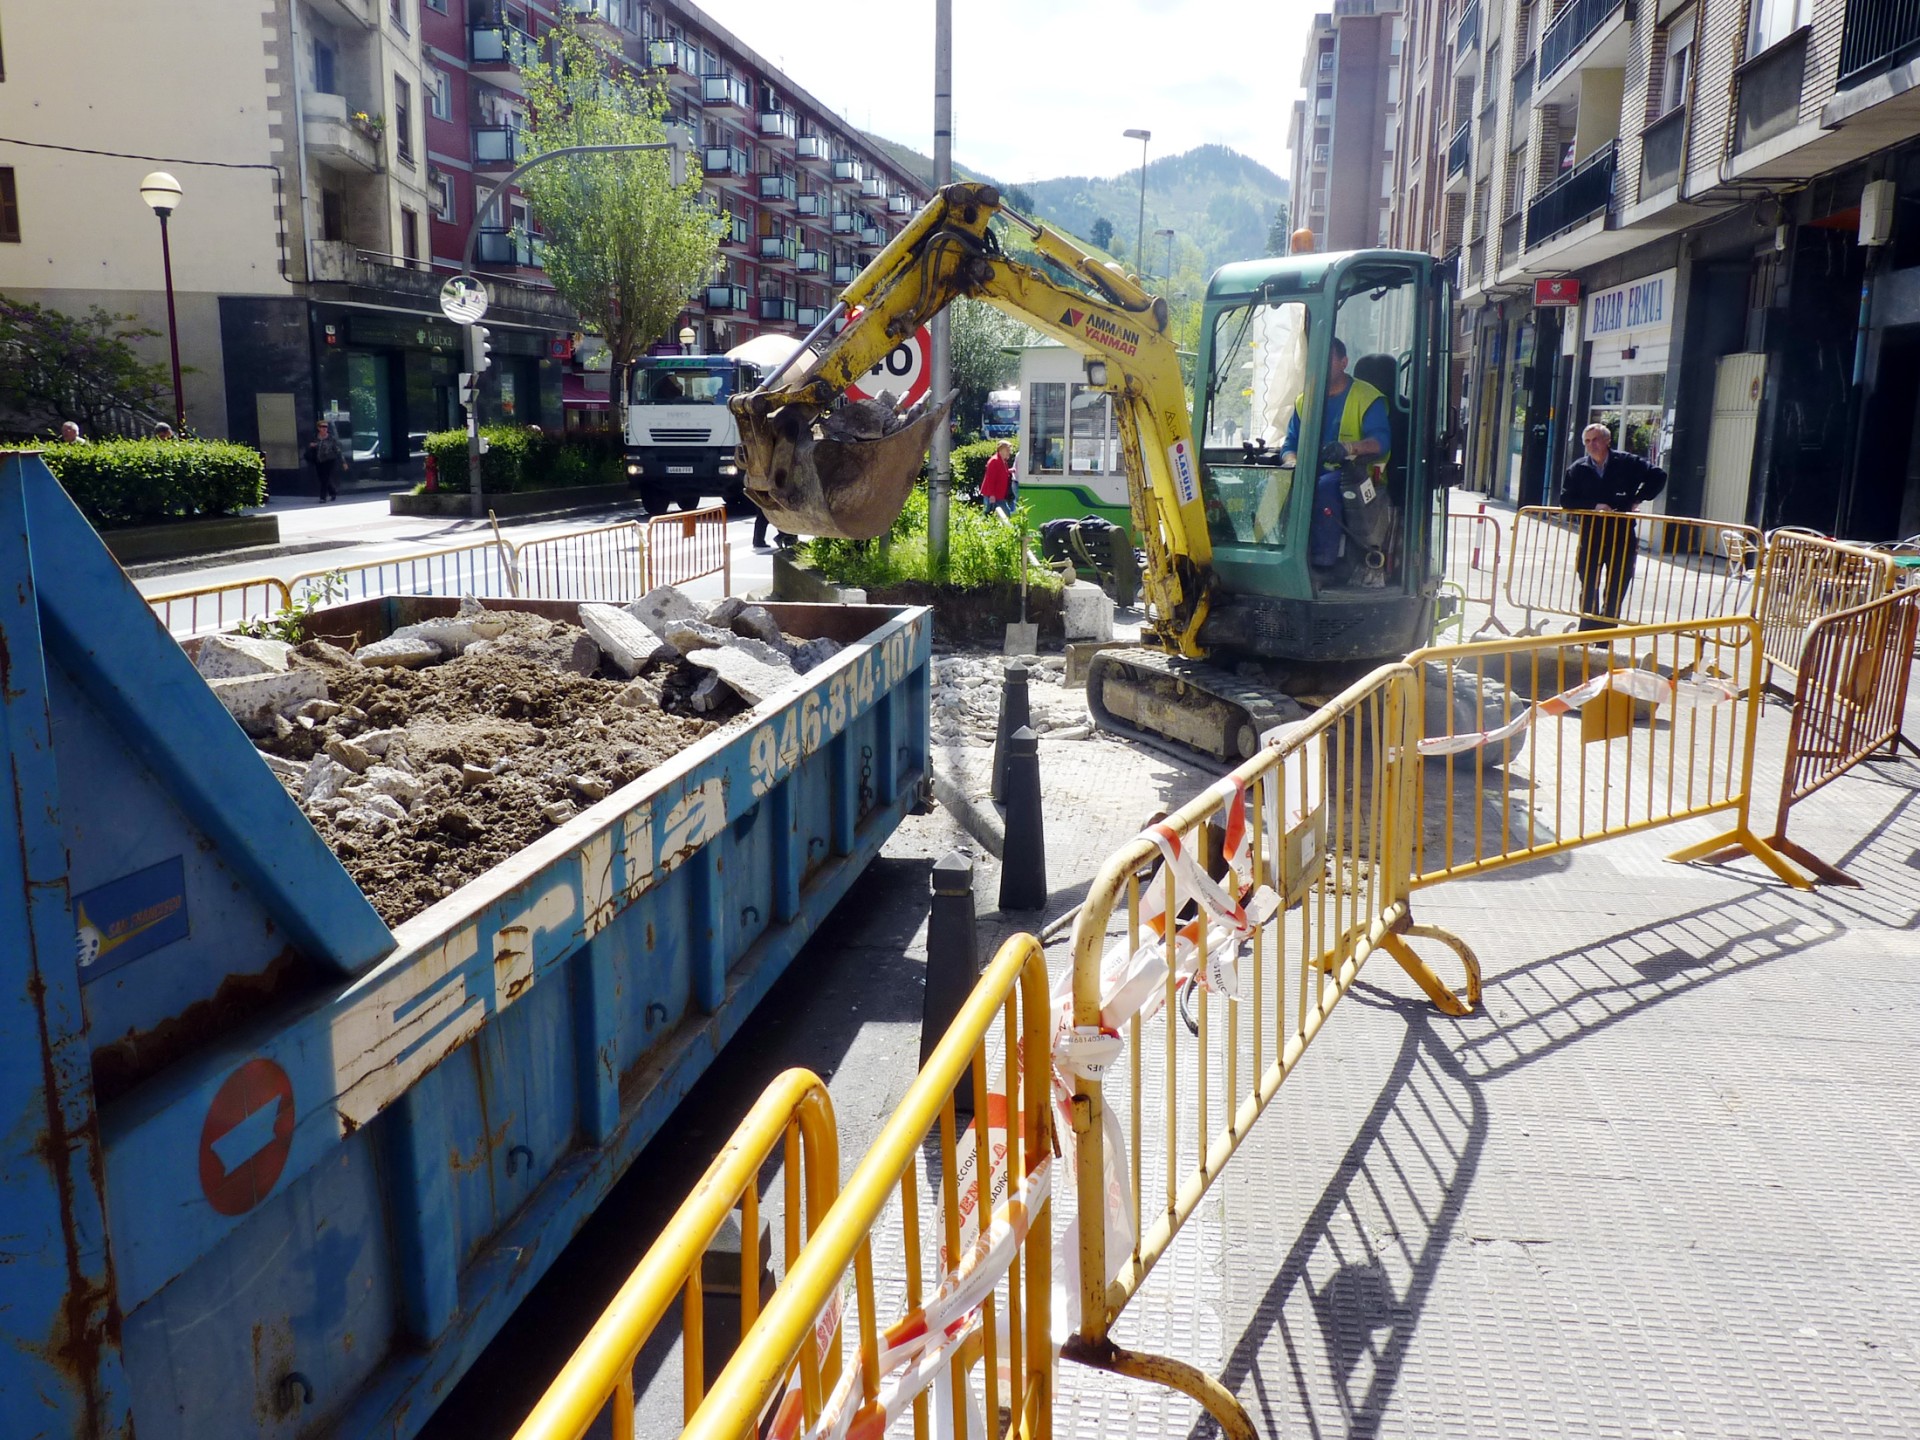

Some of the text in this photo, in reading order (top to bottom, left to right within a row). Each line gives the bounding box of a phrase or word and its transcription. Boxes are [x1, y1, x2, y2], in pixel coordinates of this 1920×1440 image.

[1592, 279, 1663, 334] BAZAR ERMUA
[1085, 326, 1137, 357] YANMAR
[1178, 454, 1193, 501] LASUEN
